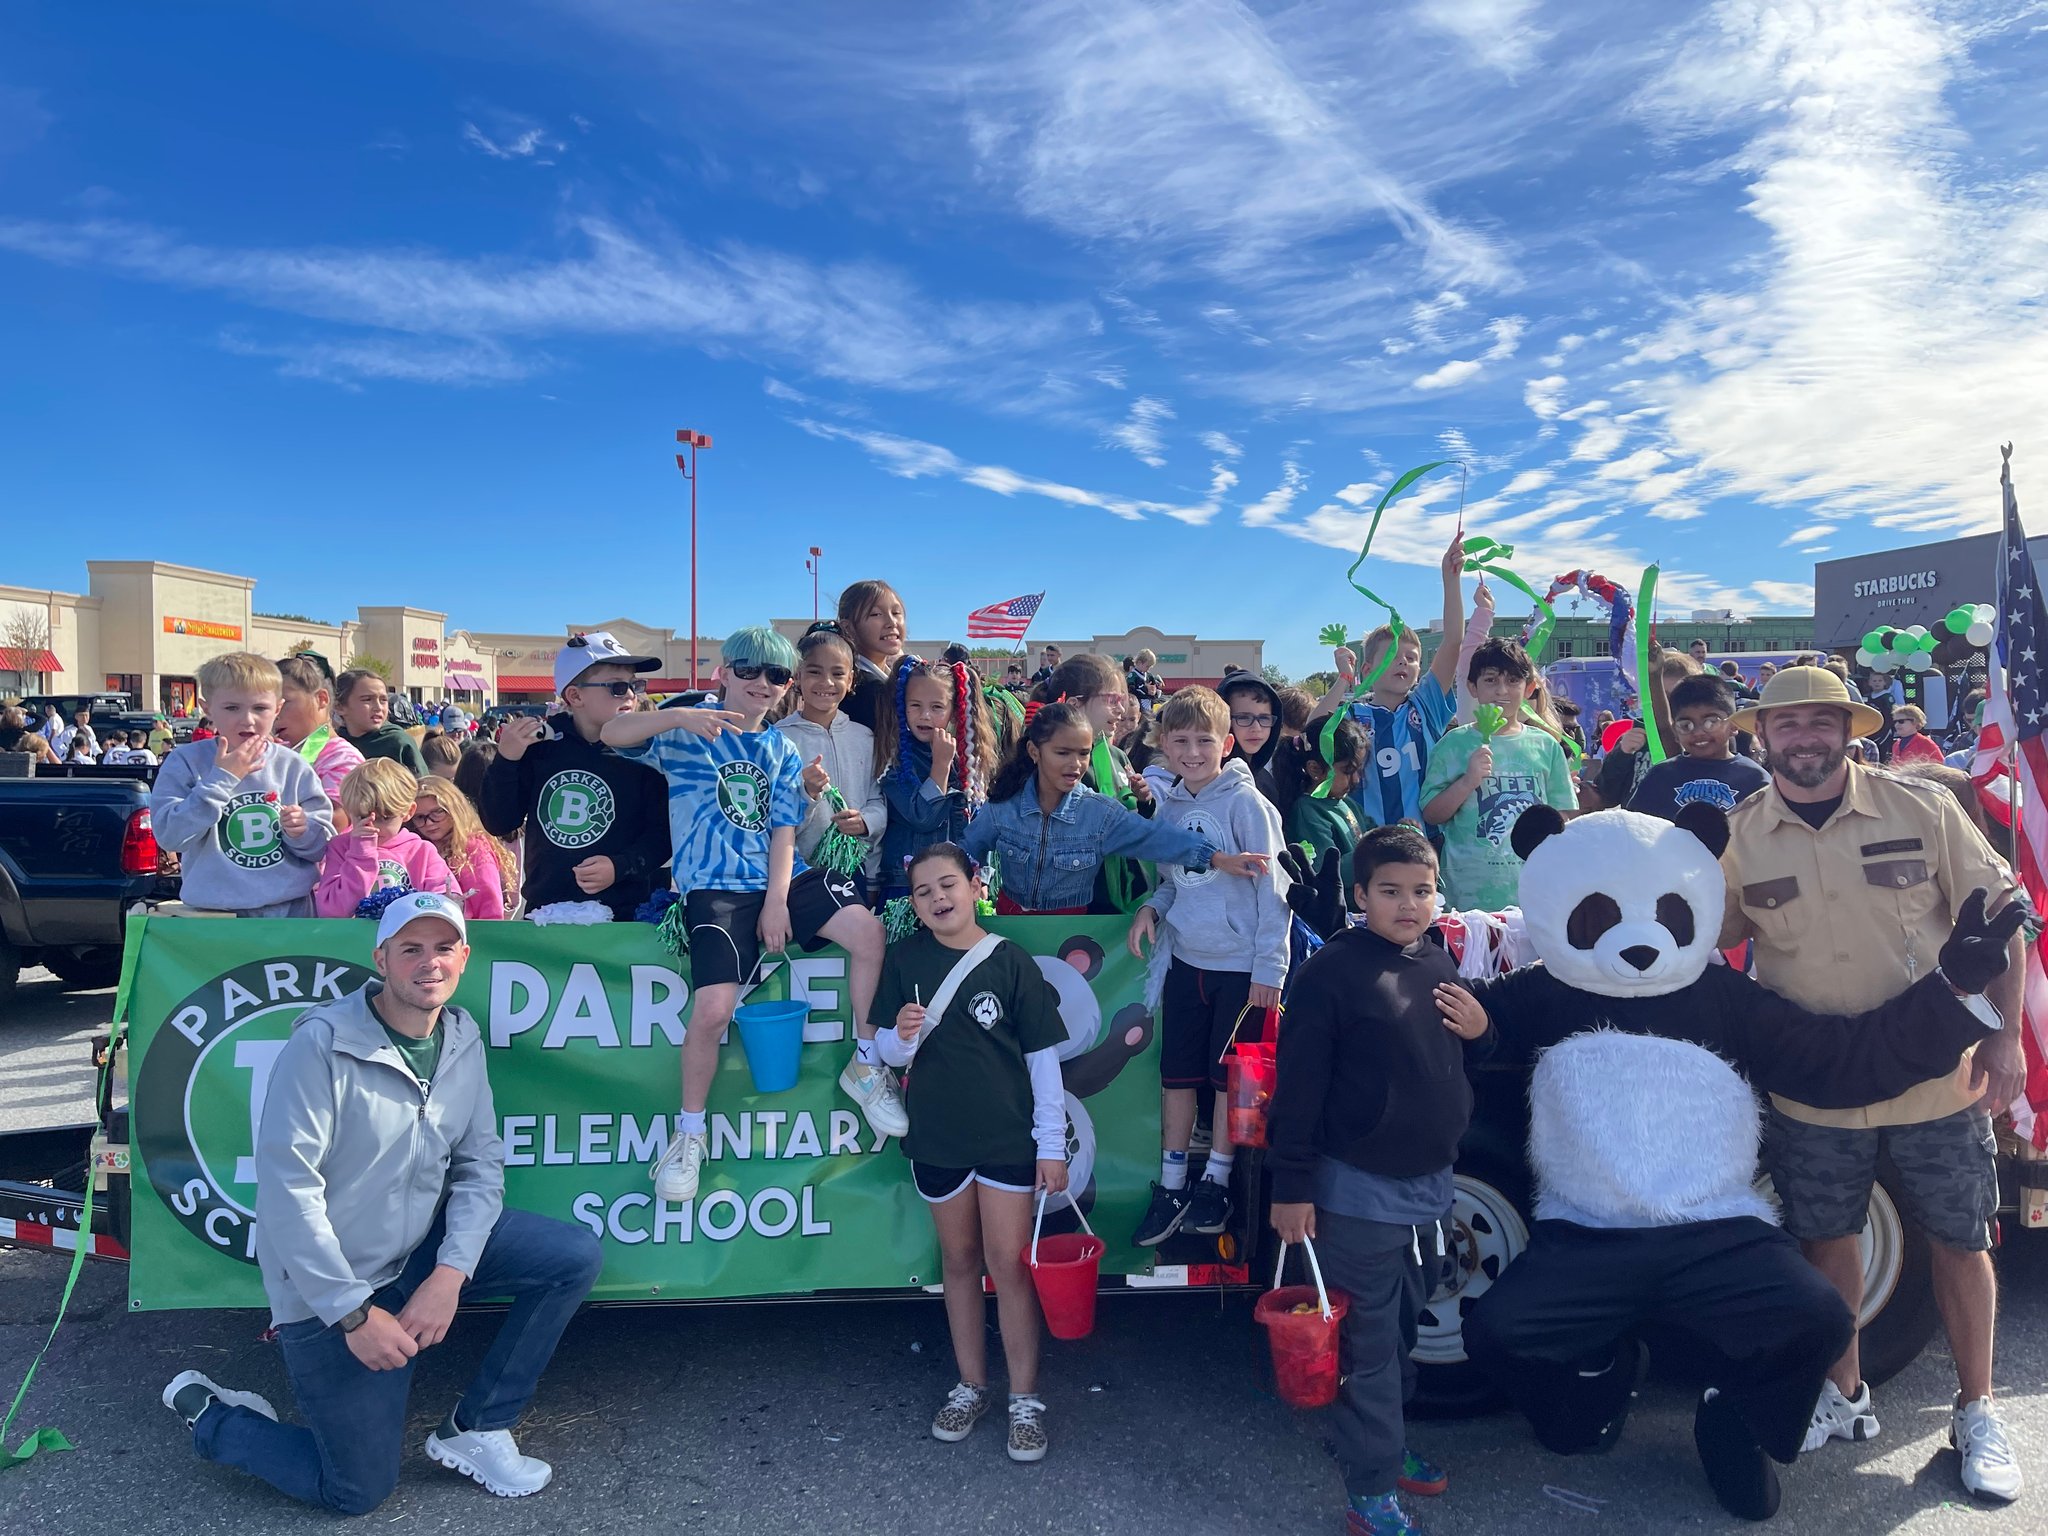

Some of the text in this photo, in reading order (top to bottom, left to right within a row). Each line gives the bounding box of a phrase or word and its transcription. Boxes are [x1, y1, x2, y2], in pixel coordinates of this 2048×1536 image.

[1854, 570, 1936, 598] STARBUCKS
[1877, 597, 1916, 608] DRIVE THRU
[724, 763, 767, 788] ARKER
[1376, 741, 1421, 778] 91
[549, 773, 607, 797] PARKER
[727, 781, 755, 817] B
[1677, 783, 1733, 806] KNICKS
[556, 789, 590, 826] B
[237, 812, 274, 849] B
[545, 821, 601, 845] SCHOOL
[226, 848, 284, 867] SCHOO
[171, 962, 380, 1047] PARK
[489, 957, 858, 1049] PARE
[503, 1109, 892, 1167] ELEMNTARY
[572, 1184, 832, 1244] SCHOOL
